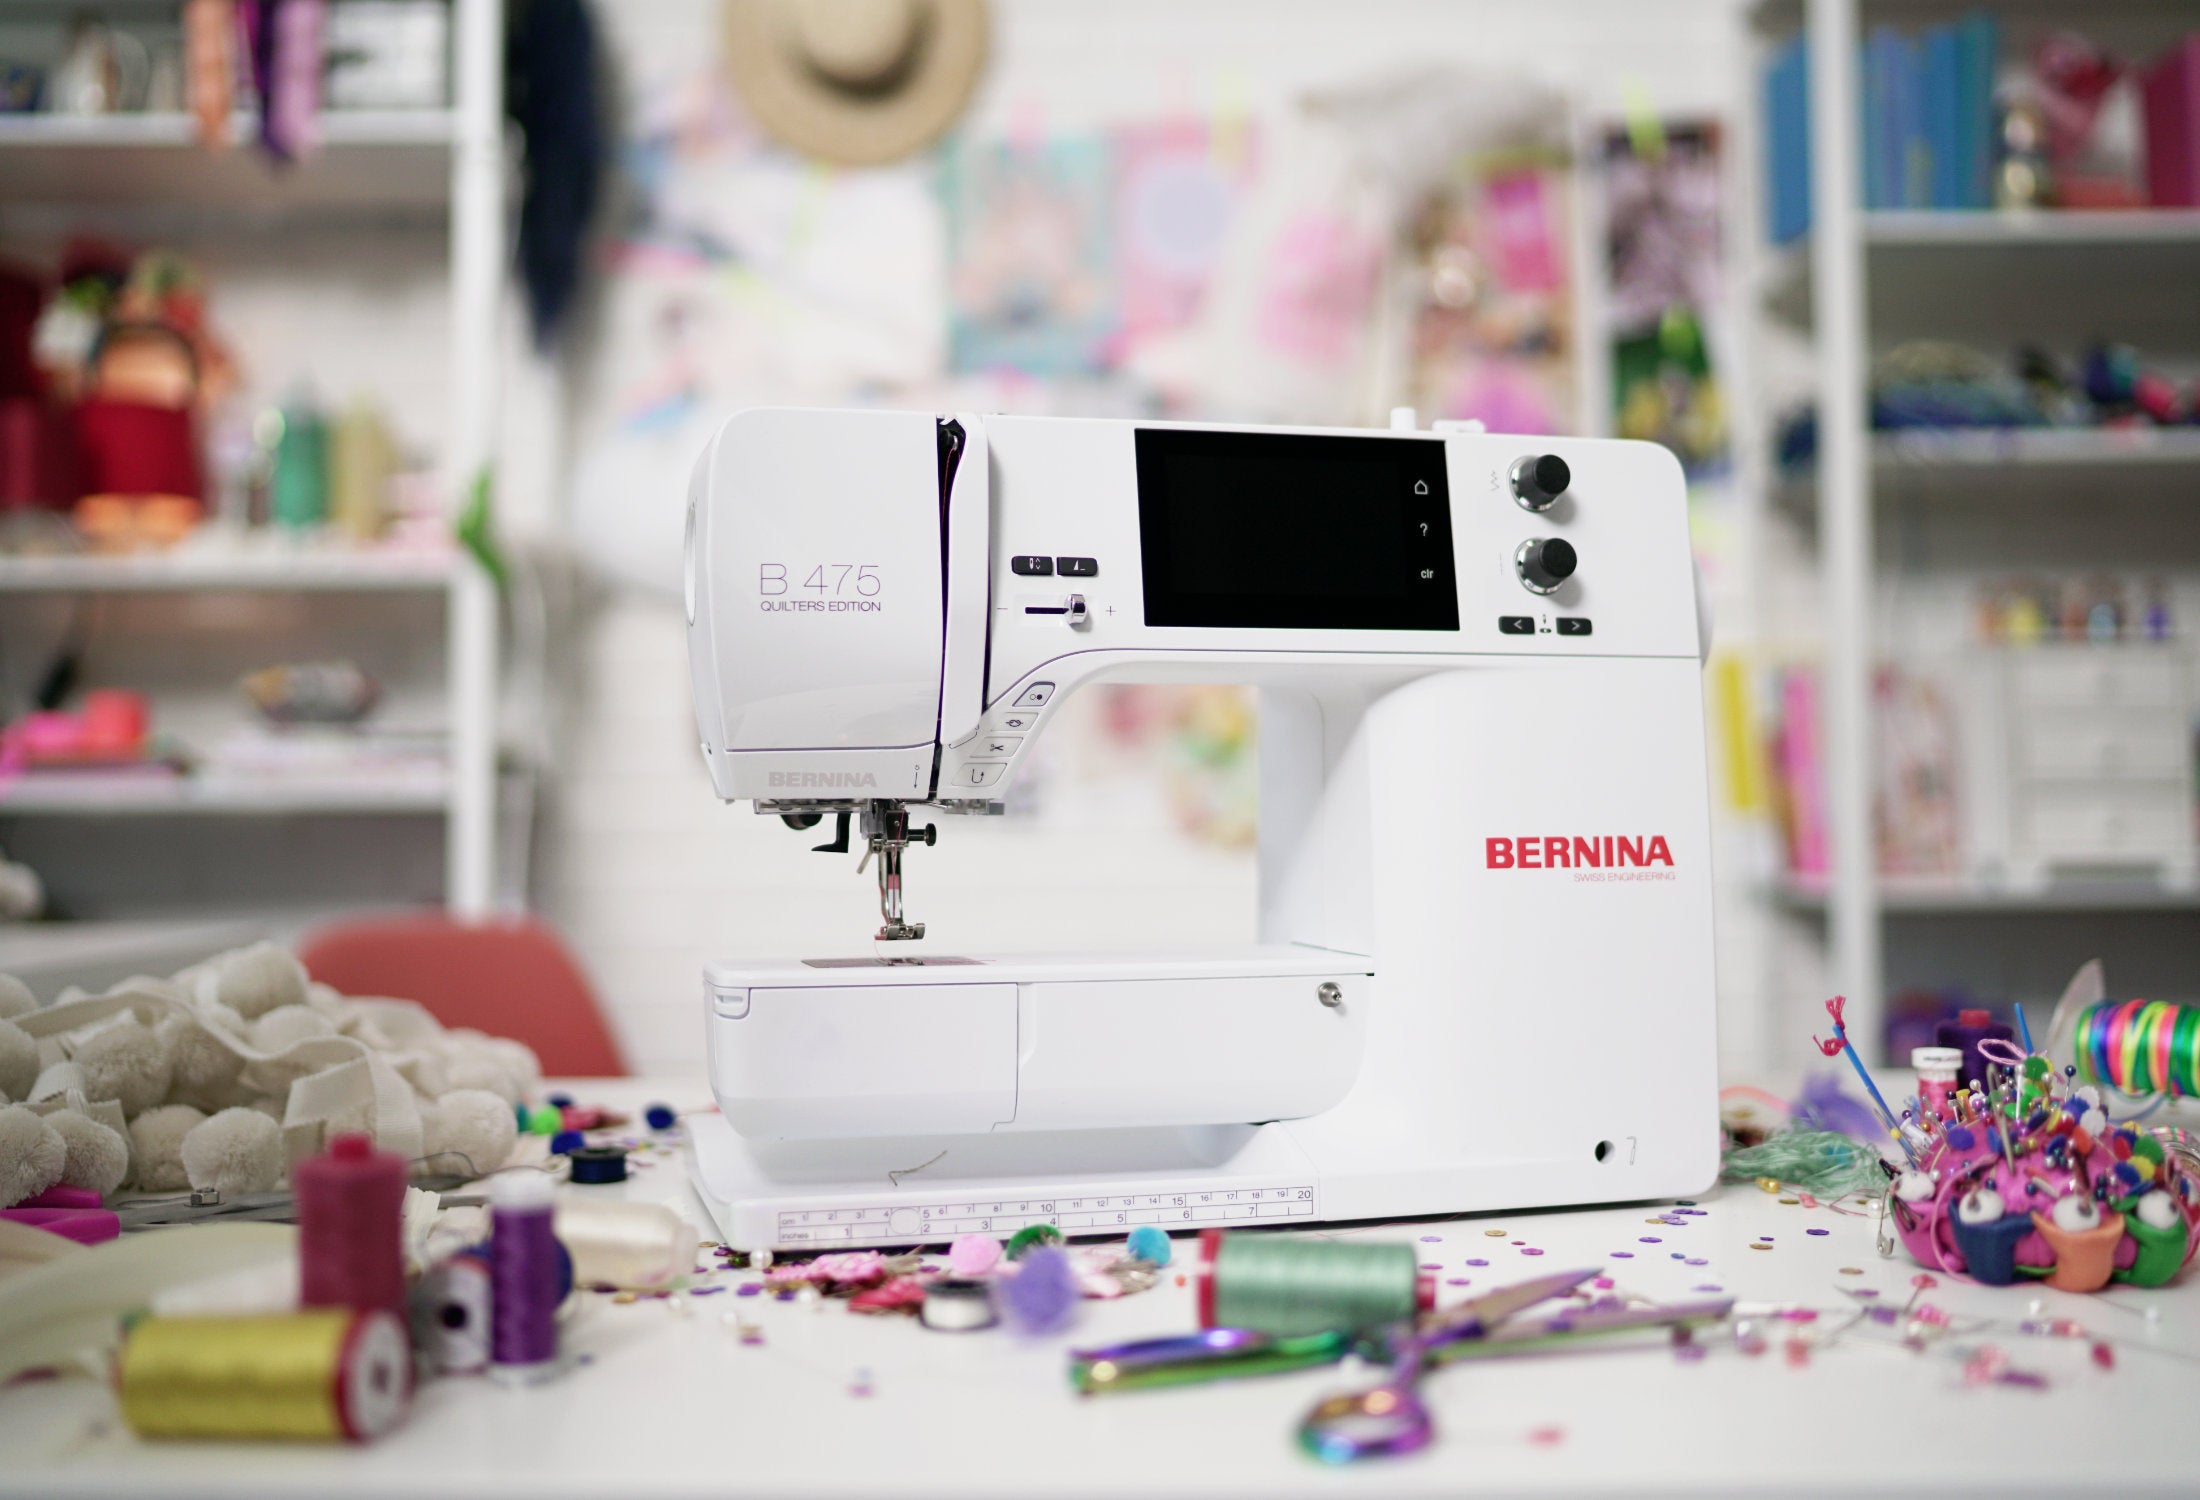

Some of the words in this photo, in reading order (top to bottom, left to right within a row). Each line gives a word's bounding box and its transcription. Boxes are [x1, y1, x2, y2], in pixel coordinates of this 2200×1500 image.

[760, 563, 788, 595] B
[803, 564, 880, 597] 475
[1420, 568, 1434, 579] clr
[760, 601, 825, 612] QUILTERS
[828, 601, 881, 612] EDITION
[768, 771, 877, 788] BERNINA
[1485, 835, 1675, 869] BERNINA
[1573, 872, 1606, 882] SWISS
[1607, 871, 1676, 882] ENGINEERING
[923, 1210, 929, 1218] 5
[1041, 1204, 1052, 1212] 10
[1173, 1197, 1183, 1205] 15
[1298, 1191, 1311, 1199] 20
[845, 1228, 849, 1236] 1
[923, 1224, 930, 1232] 2
[982, 1221, 988, 1229] 3
[1117, 1214, 1123, 1222] 5
[1183, 1210, 1189, 1218] 6
[1249, 1207, 1254, 1215] 7
